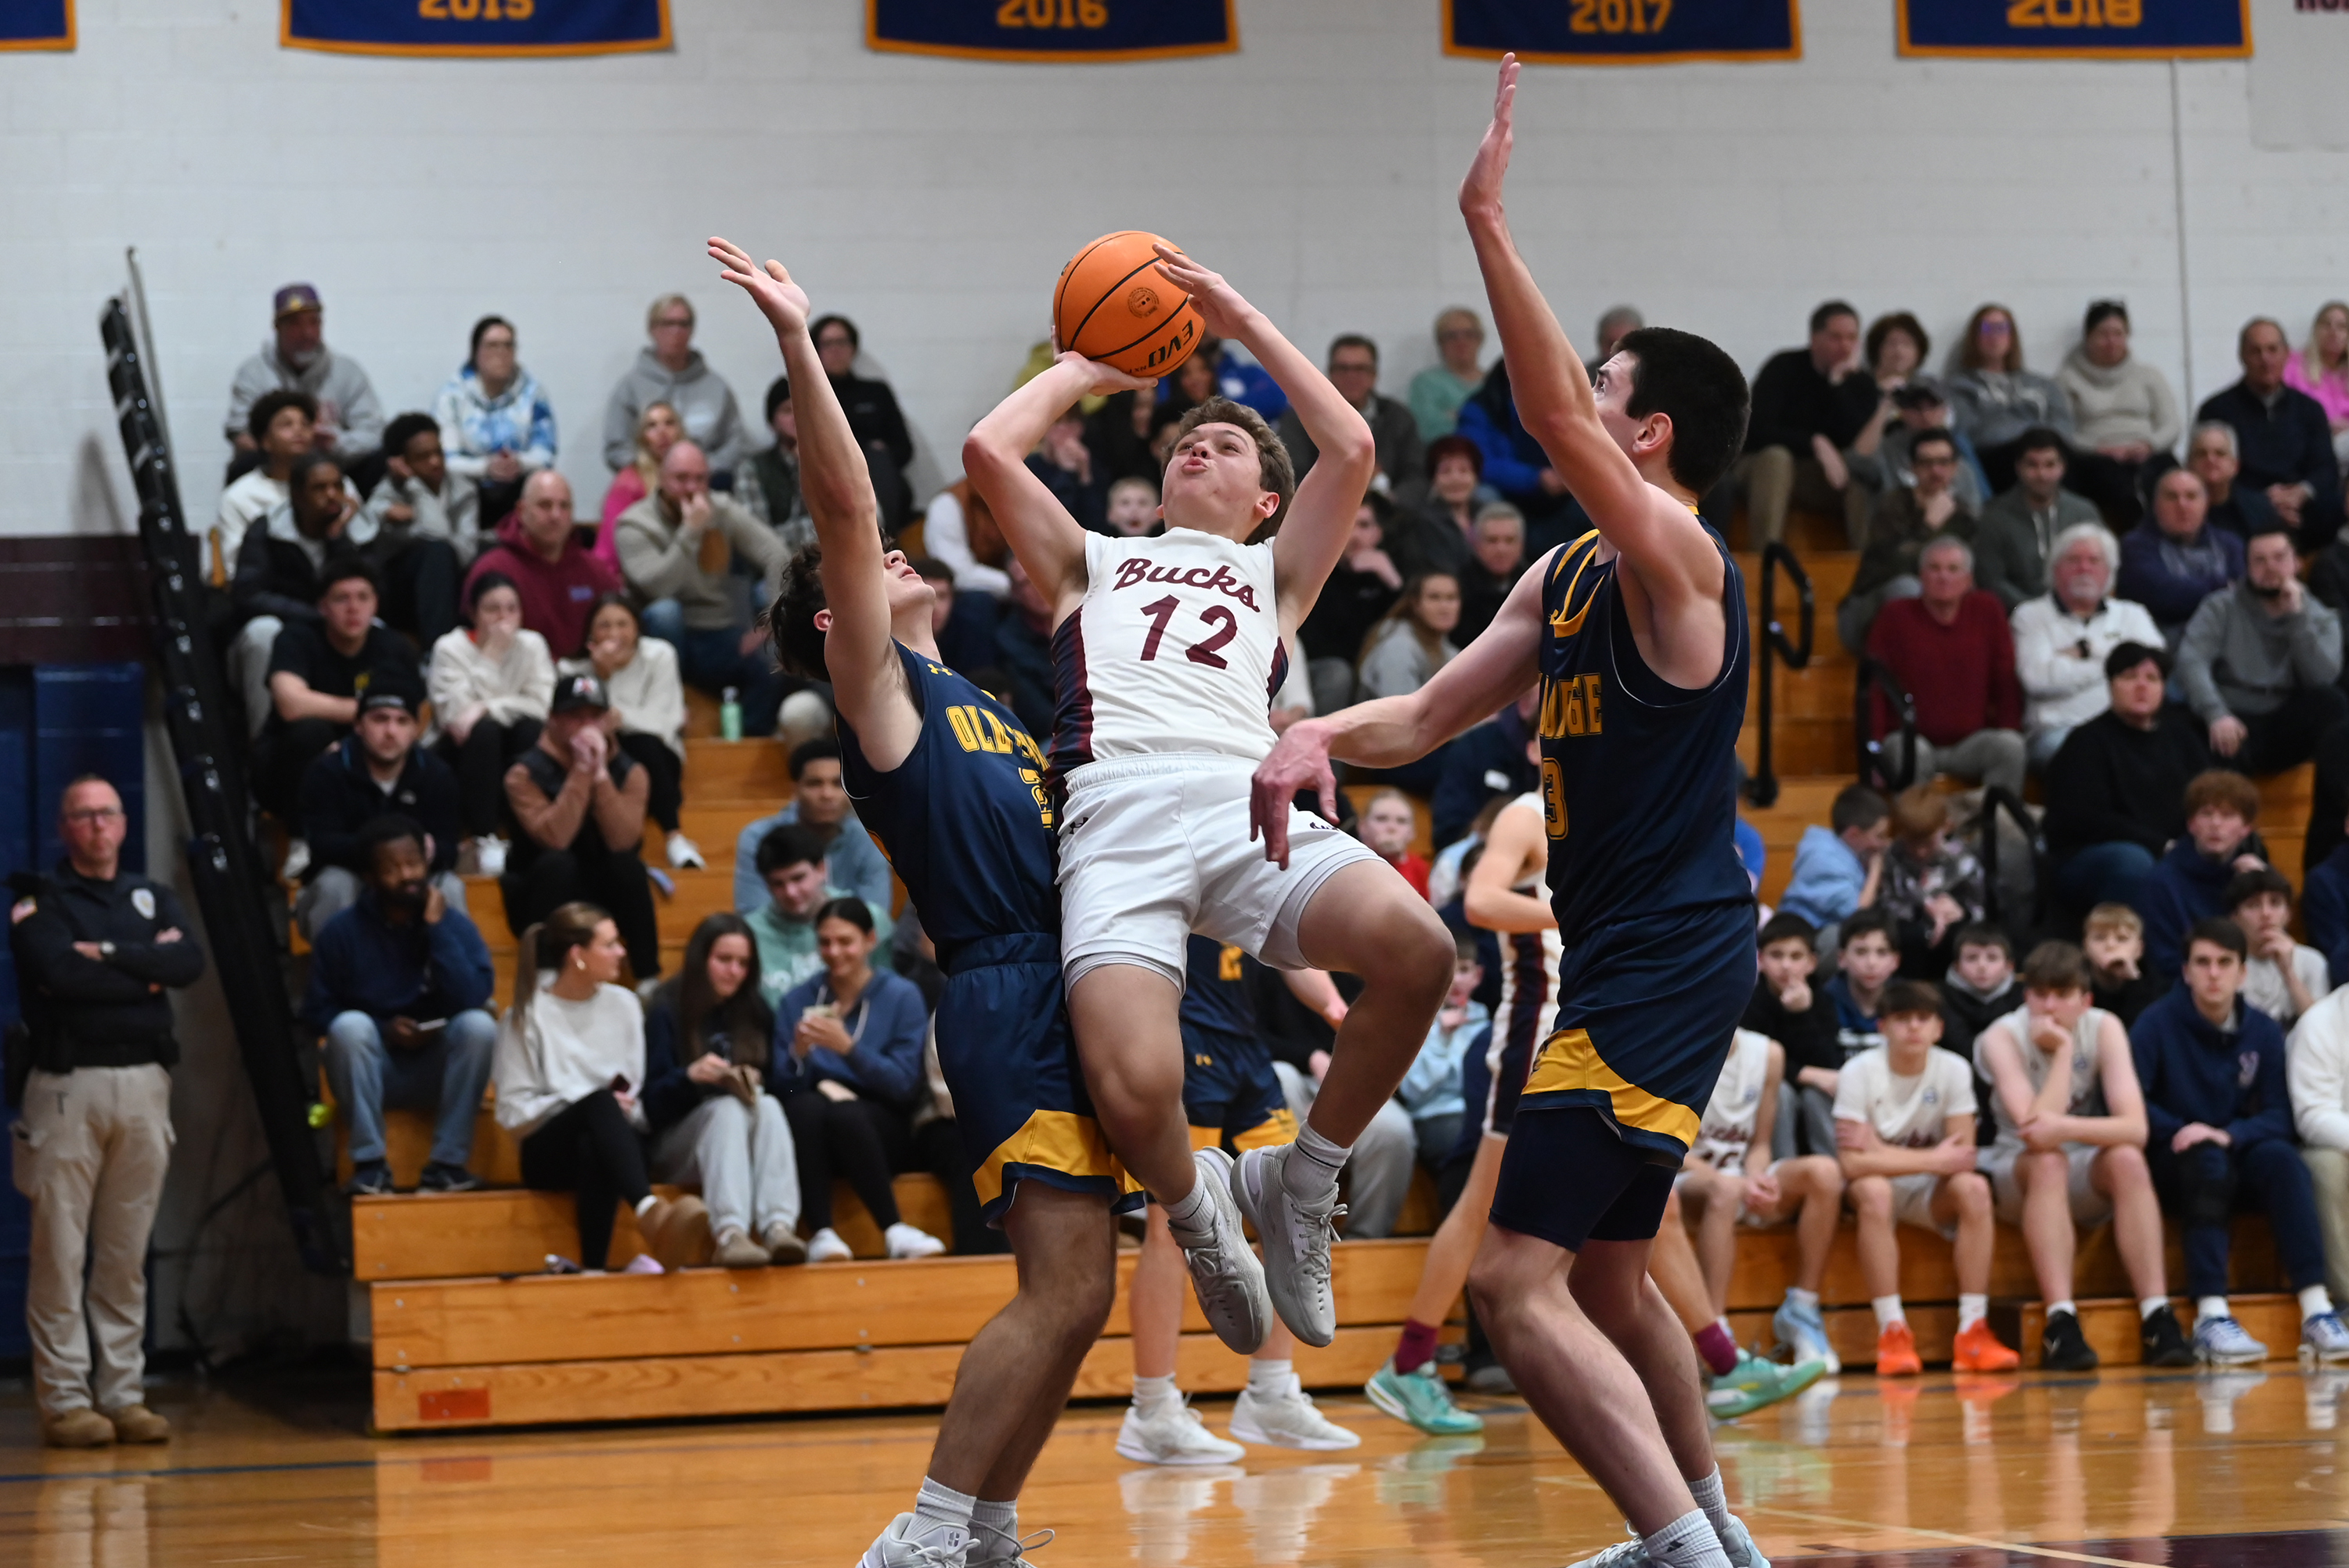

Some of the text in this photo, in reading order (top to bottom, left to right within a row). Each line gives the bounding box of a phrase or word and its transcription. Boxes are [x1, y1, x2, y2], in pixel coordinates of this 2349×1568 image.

[997, 0, 1109, 28] 2016
[1570, 0, 1672, 34] 2017
[1149, 319, 1193, 367] EVO
[1112, 558, 1261, 613] Bucks
[1140, 594, 1238, 670] 12
